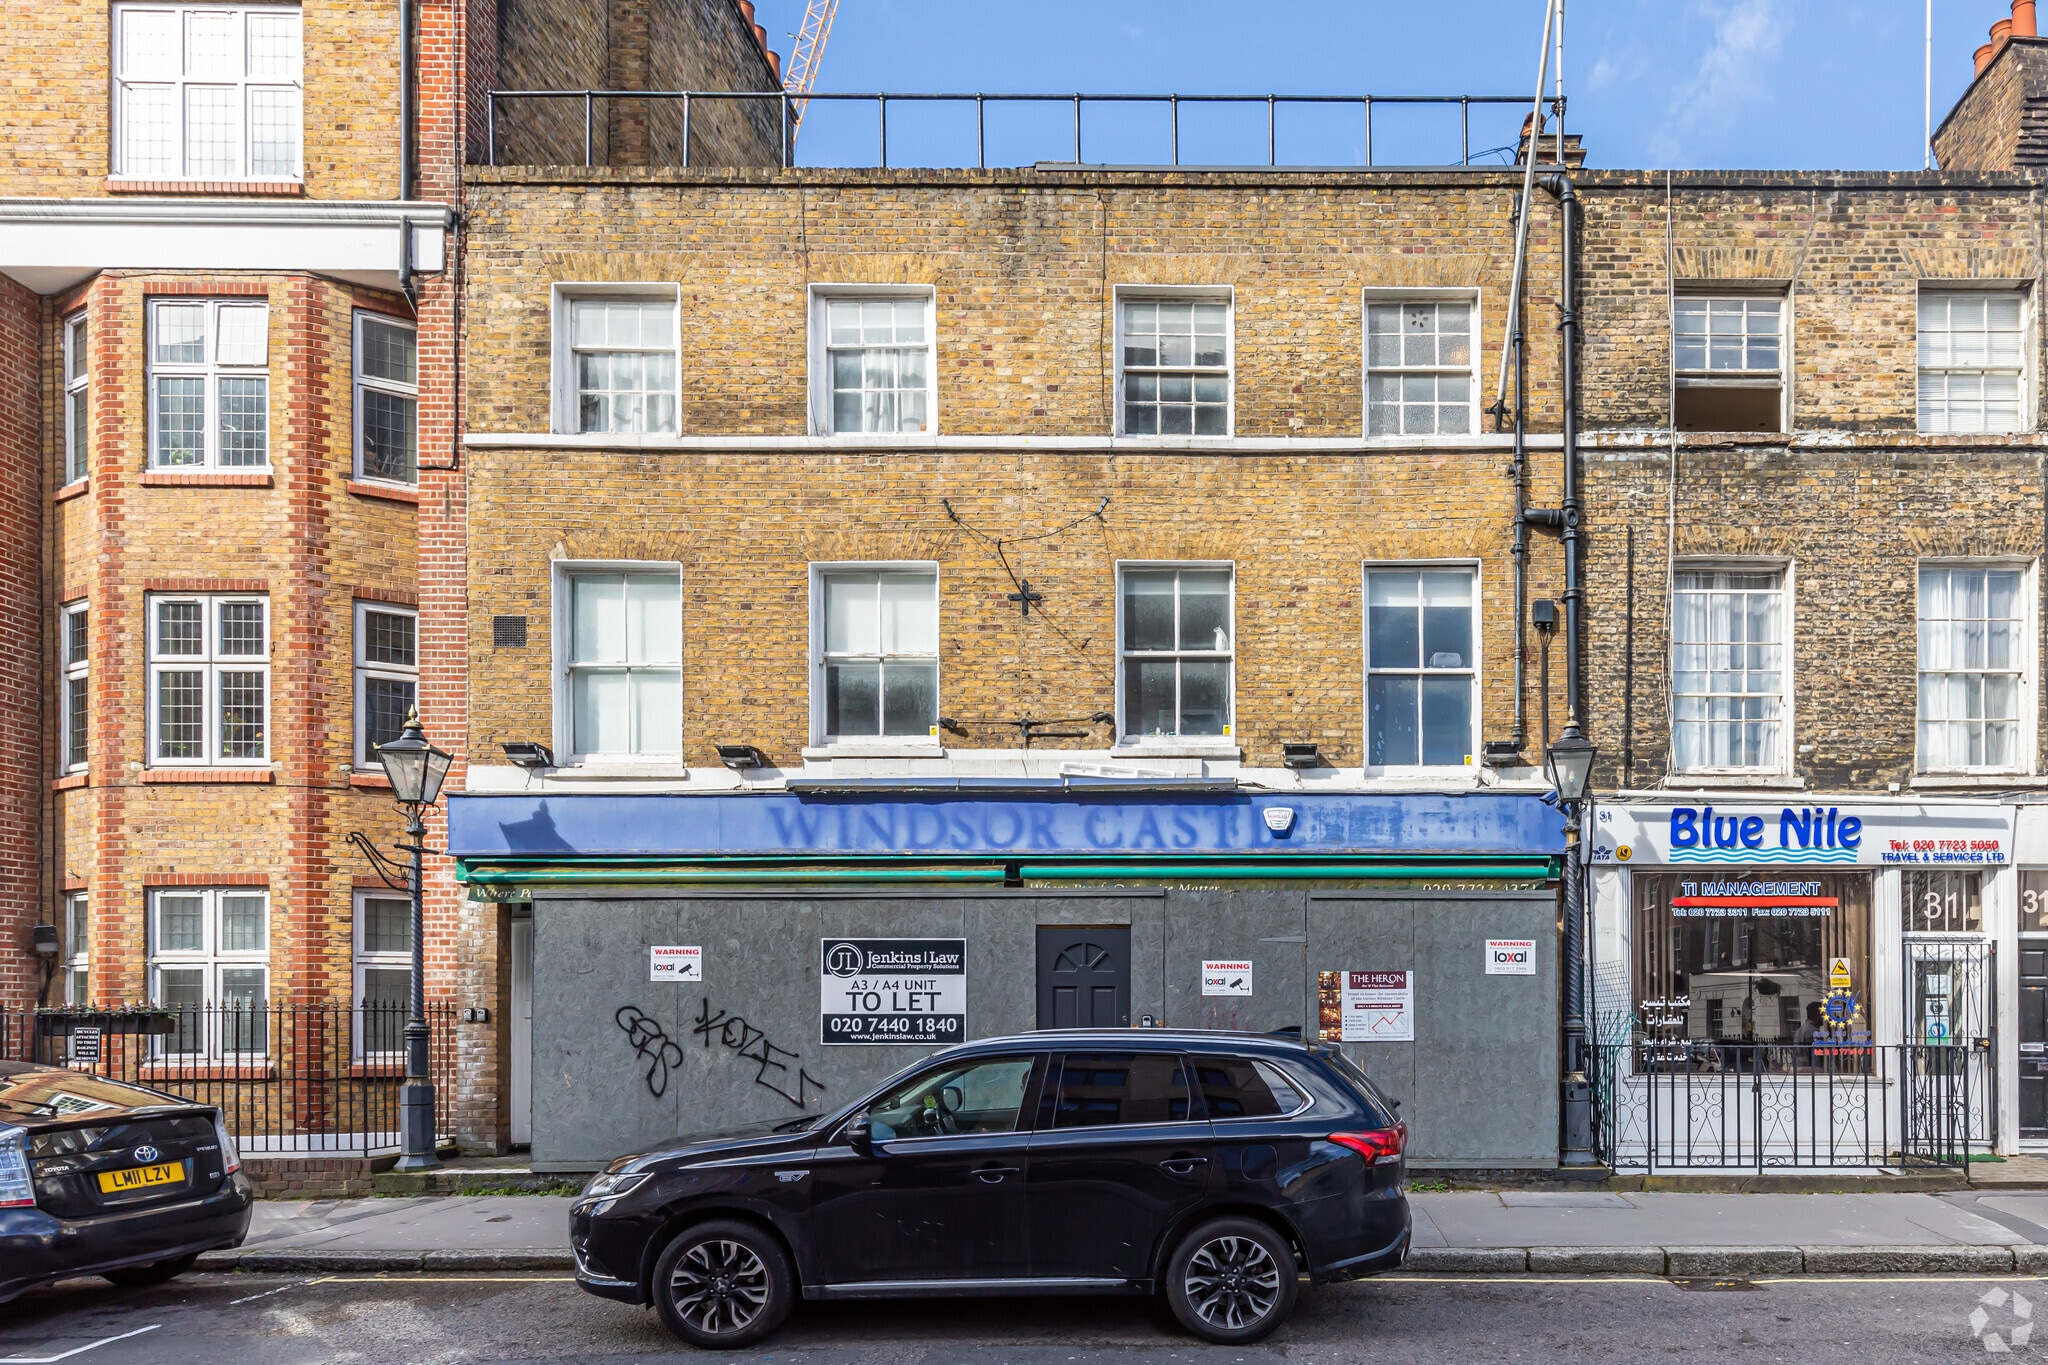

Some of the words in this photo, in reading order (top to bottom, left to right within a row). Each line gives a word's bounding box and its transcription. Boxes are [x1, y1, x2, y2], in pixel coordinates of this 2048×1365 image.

[766, 804, 1060, 849] WINDSOR
[1670, 807, 1764, 848] Blue
[1780, 807, 1862, 848] Nile
[1889, 840, 1909, 850] Tel:
[1913, 840, 1934, 850] 020
[1939, 840, 1967, 850] 7723
[1970, 840, 1999, 850] 5050
[1881, 852, 1919, 861] TRAVEL
[1922, 852, 1929, 861] &
[1933, 852, 1983, 861] SERVICES
[1986, 852, 2005, 861] LTD
[476, 888, 515, 898] Where
[1702, 881, 1821, 896] MANAGEMENT
[1924, 892, 1957, 919] 31
[2023, 889, 2048, 914] 31
[866, 951, 922, 969] Jenkins
[929, 951, 959, 964] Law
[1494, 951, 1527, 963] loxal
[654, 963, 675, 971] loxal
[851, 980, 868, 990] A3
[873, 980, 879, 990] /
[882, 980, 900, 990] A4
[904, 980, 937, 990] UNIT
[1205, 977, 1226, 985] loxal
[1351, 974, 1369, 983] THE
[1371, 974, 1404, 984] HERON
[845, 992, 882, 1012] TO
[892, 992, 942, 1012] LET
[1640, 996, 1666, 1010] تيسير
[1668, 995, 1691, 1010] مكتب
[831, 1018, 862, 1032] 020
[868, 1018, 910, 1032] 7440
[916, 1018, 957, 1032] 1840
[1646, 1014, 1684, 1027] للعقارات
[850, 1033, 936, 1041] www.jenkinslaw.co.uk
[43, 1165, 70, 1173] TOYOTA
[112, 1171, 142, 1188] LM11
[143, 1165, 171, 1184] LZV
